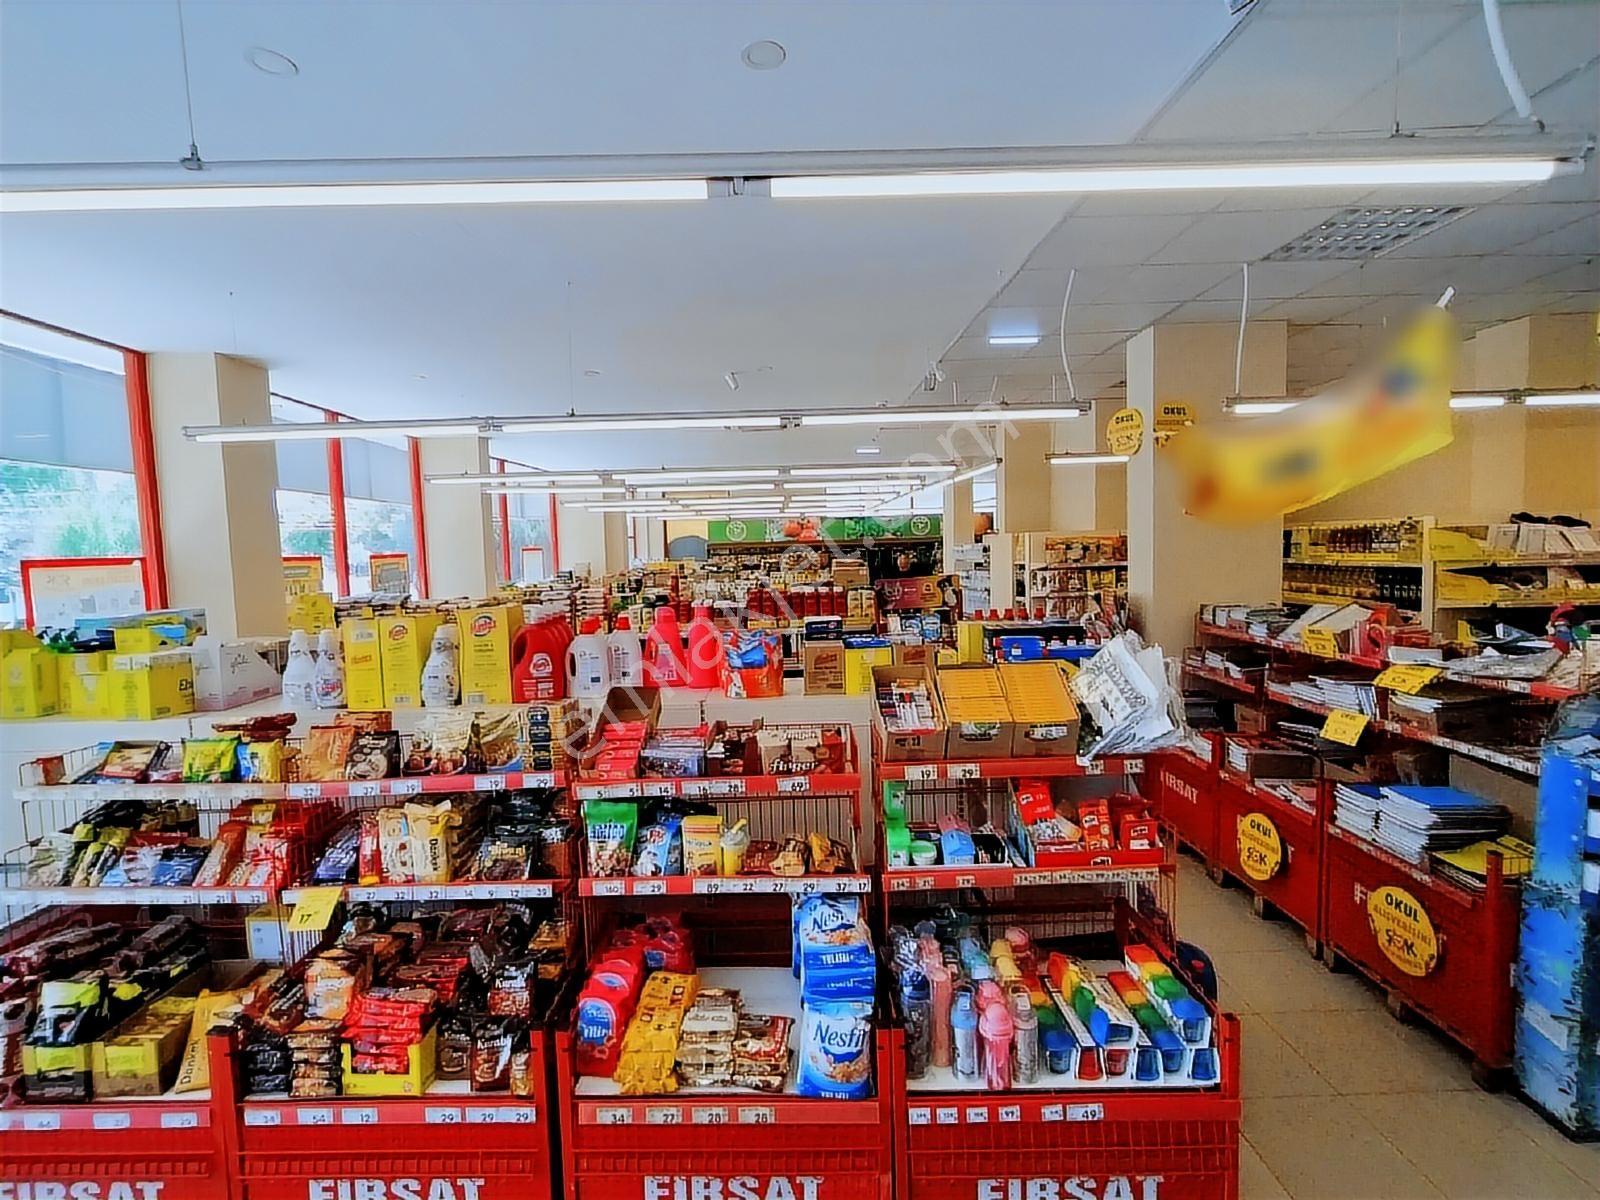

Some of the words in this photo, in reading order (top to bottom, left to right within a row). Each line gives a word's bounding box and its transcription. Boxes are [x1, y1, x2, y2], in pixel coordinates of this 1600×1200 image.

[920, 769, 931, 778] 19
[961, 768, 974, 778] 29
[536, 778, 548, 788] 29
[629, 787, 635, 796] 5
[1250, 818, 1272, 839] OKUL
[651, 884, 662, 892] 29
[743, 883, 754, 891] 22
[772, 882, 783, 891] 27
[803, 883, 816, 892] 29
[836, 882, 847, 892] 37
[858, 882, 867, 891] 17
[1385, 892, 1420, 924] OKUL
[360, 1113, 370, 1122] 12
[440, 1113, 454, 1122] 29
[481, 1113, 494, 1122] 29
[515, 1112, 529, 1122] 29
[1082, 1109, 1097, 1120] 49
